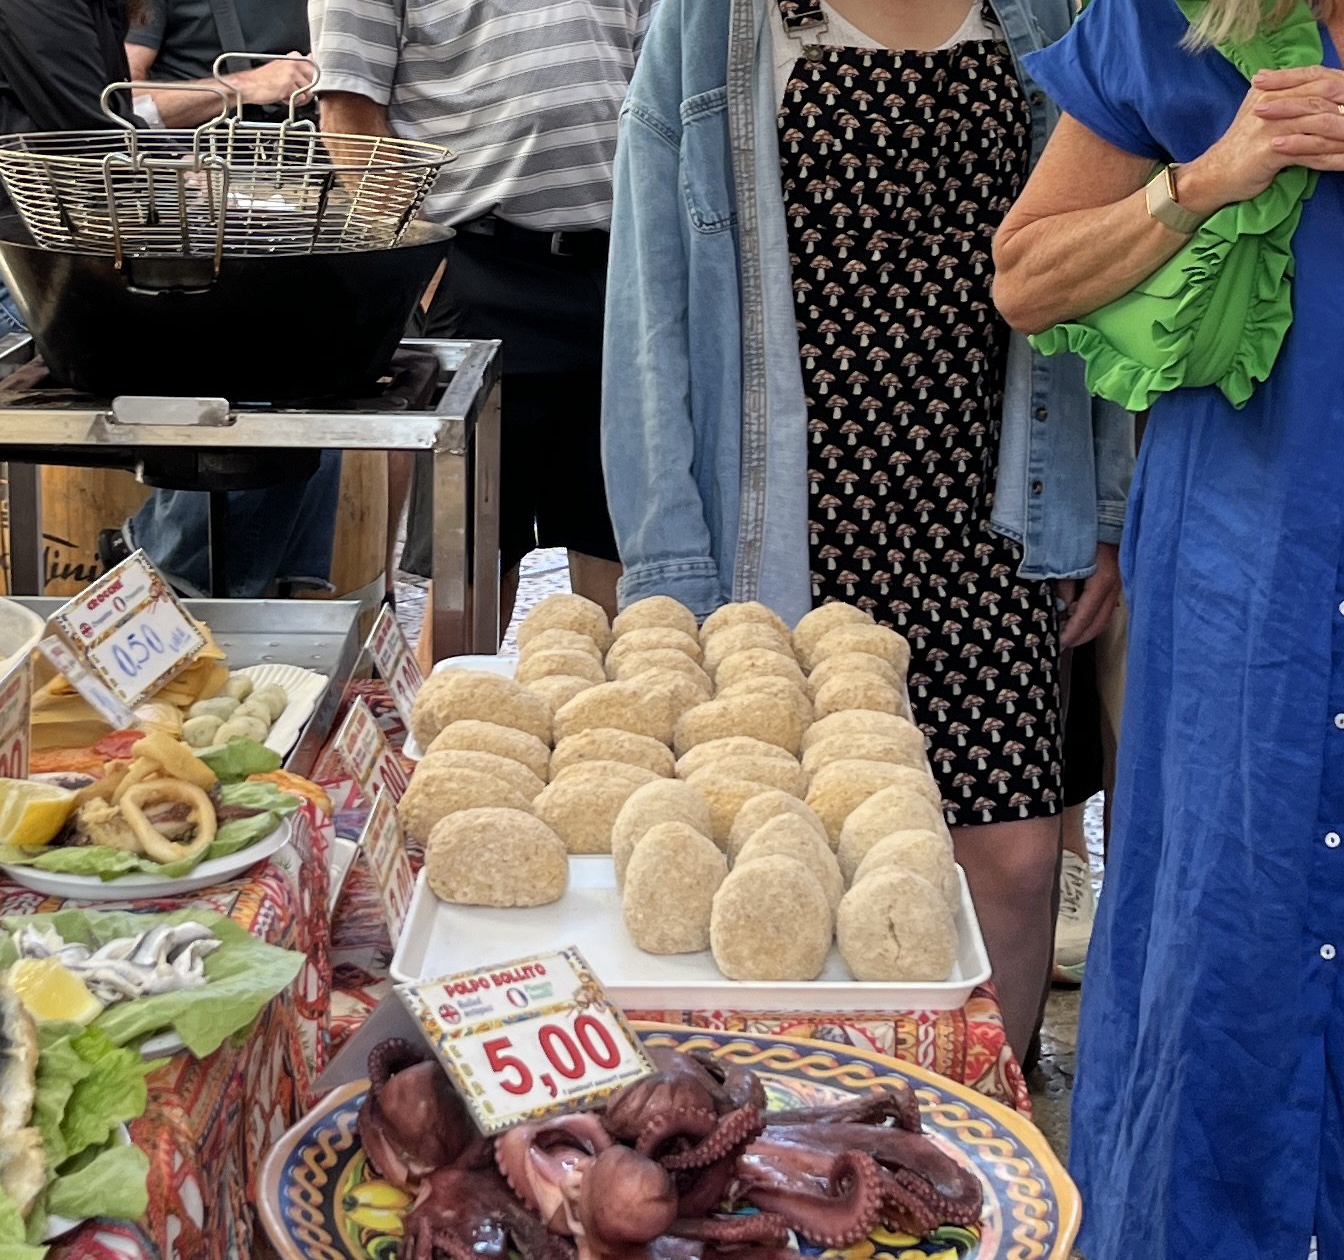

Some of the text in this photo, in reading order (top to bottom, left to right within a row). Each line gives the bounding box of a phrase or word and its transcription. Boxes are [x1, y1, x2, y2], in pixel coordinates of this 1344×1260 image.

[442, 962, 547, 998] POLPO BOLLITO
[482, 1013, 622, 1099] 5,00
